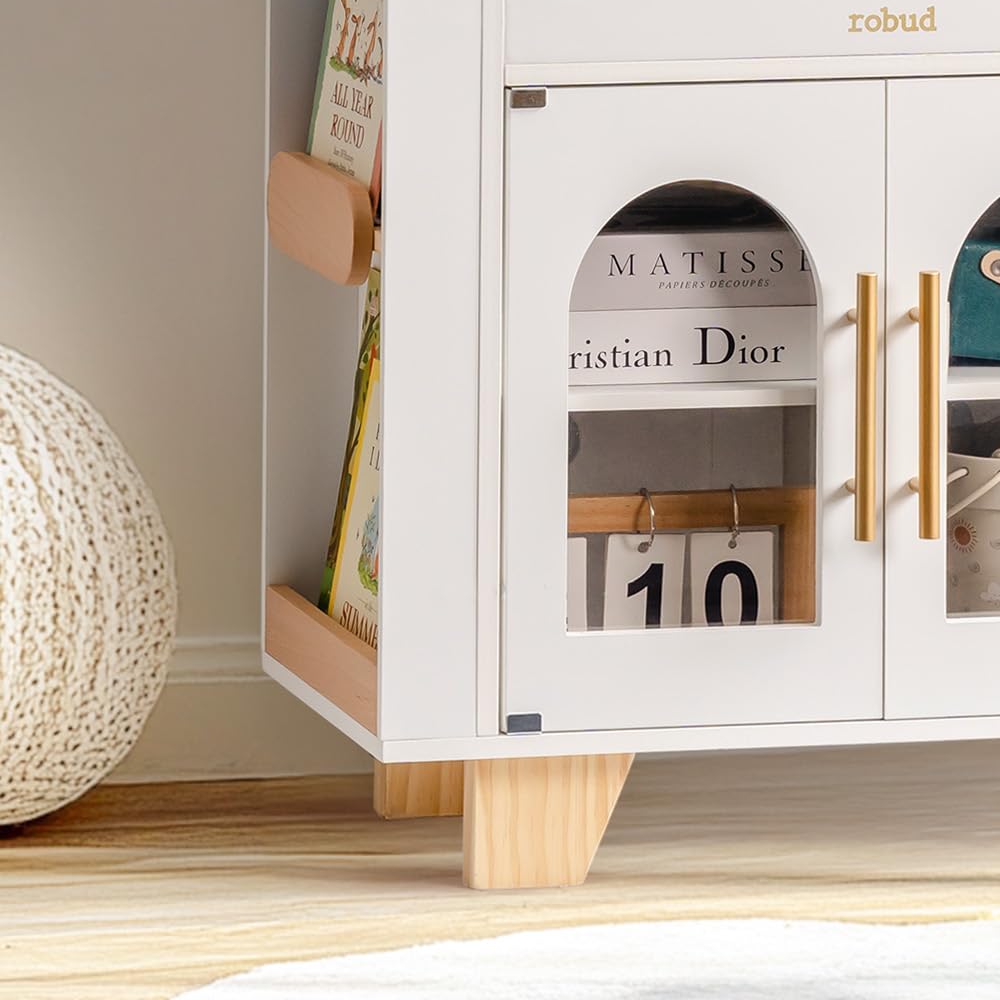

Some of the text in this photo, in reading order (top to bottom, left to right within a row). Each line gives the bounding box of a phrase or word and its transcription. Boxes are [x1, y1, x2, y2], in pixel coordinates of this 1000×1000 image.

[848, 6, 937, 33] robud
[330, 81, 374, 119] ALL YEAR
[330, 113, 365, 149] ROUND
[659, 281, 705, 289] PAPIERS
[568, 327, 785, 369] ristian Dior
